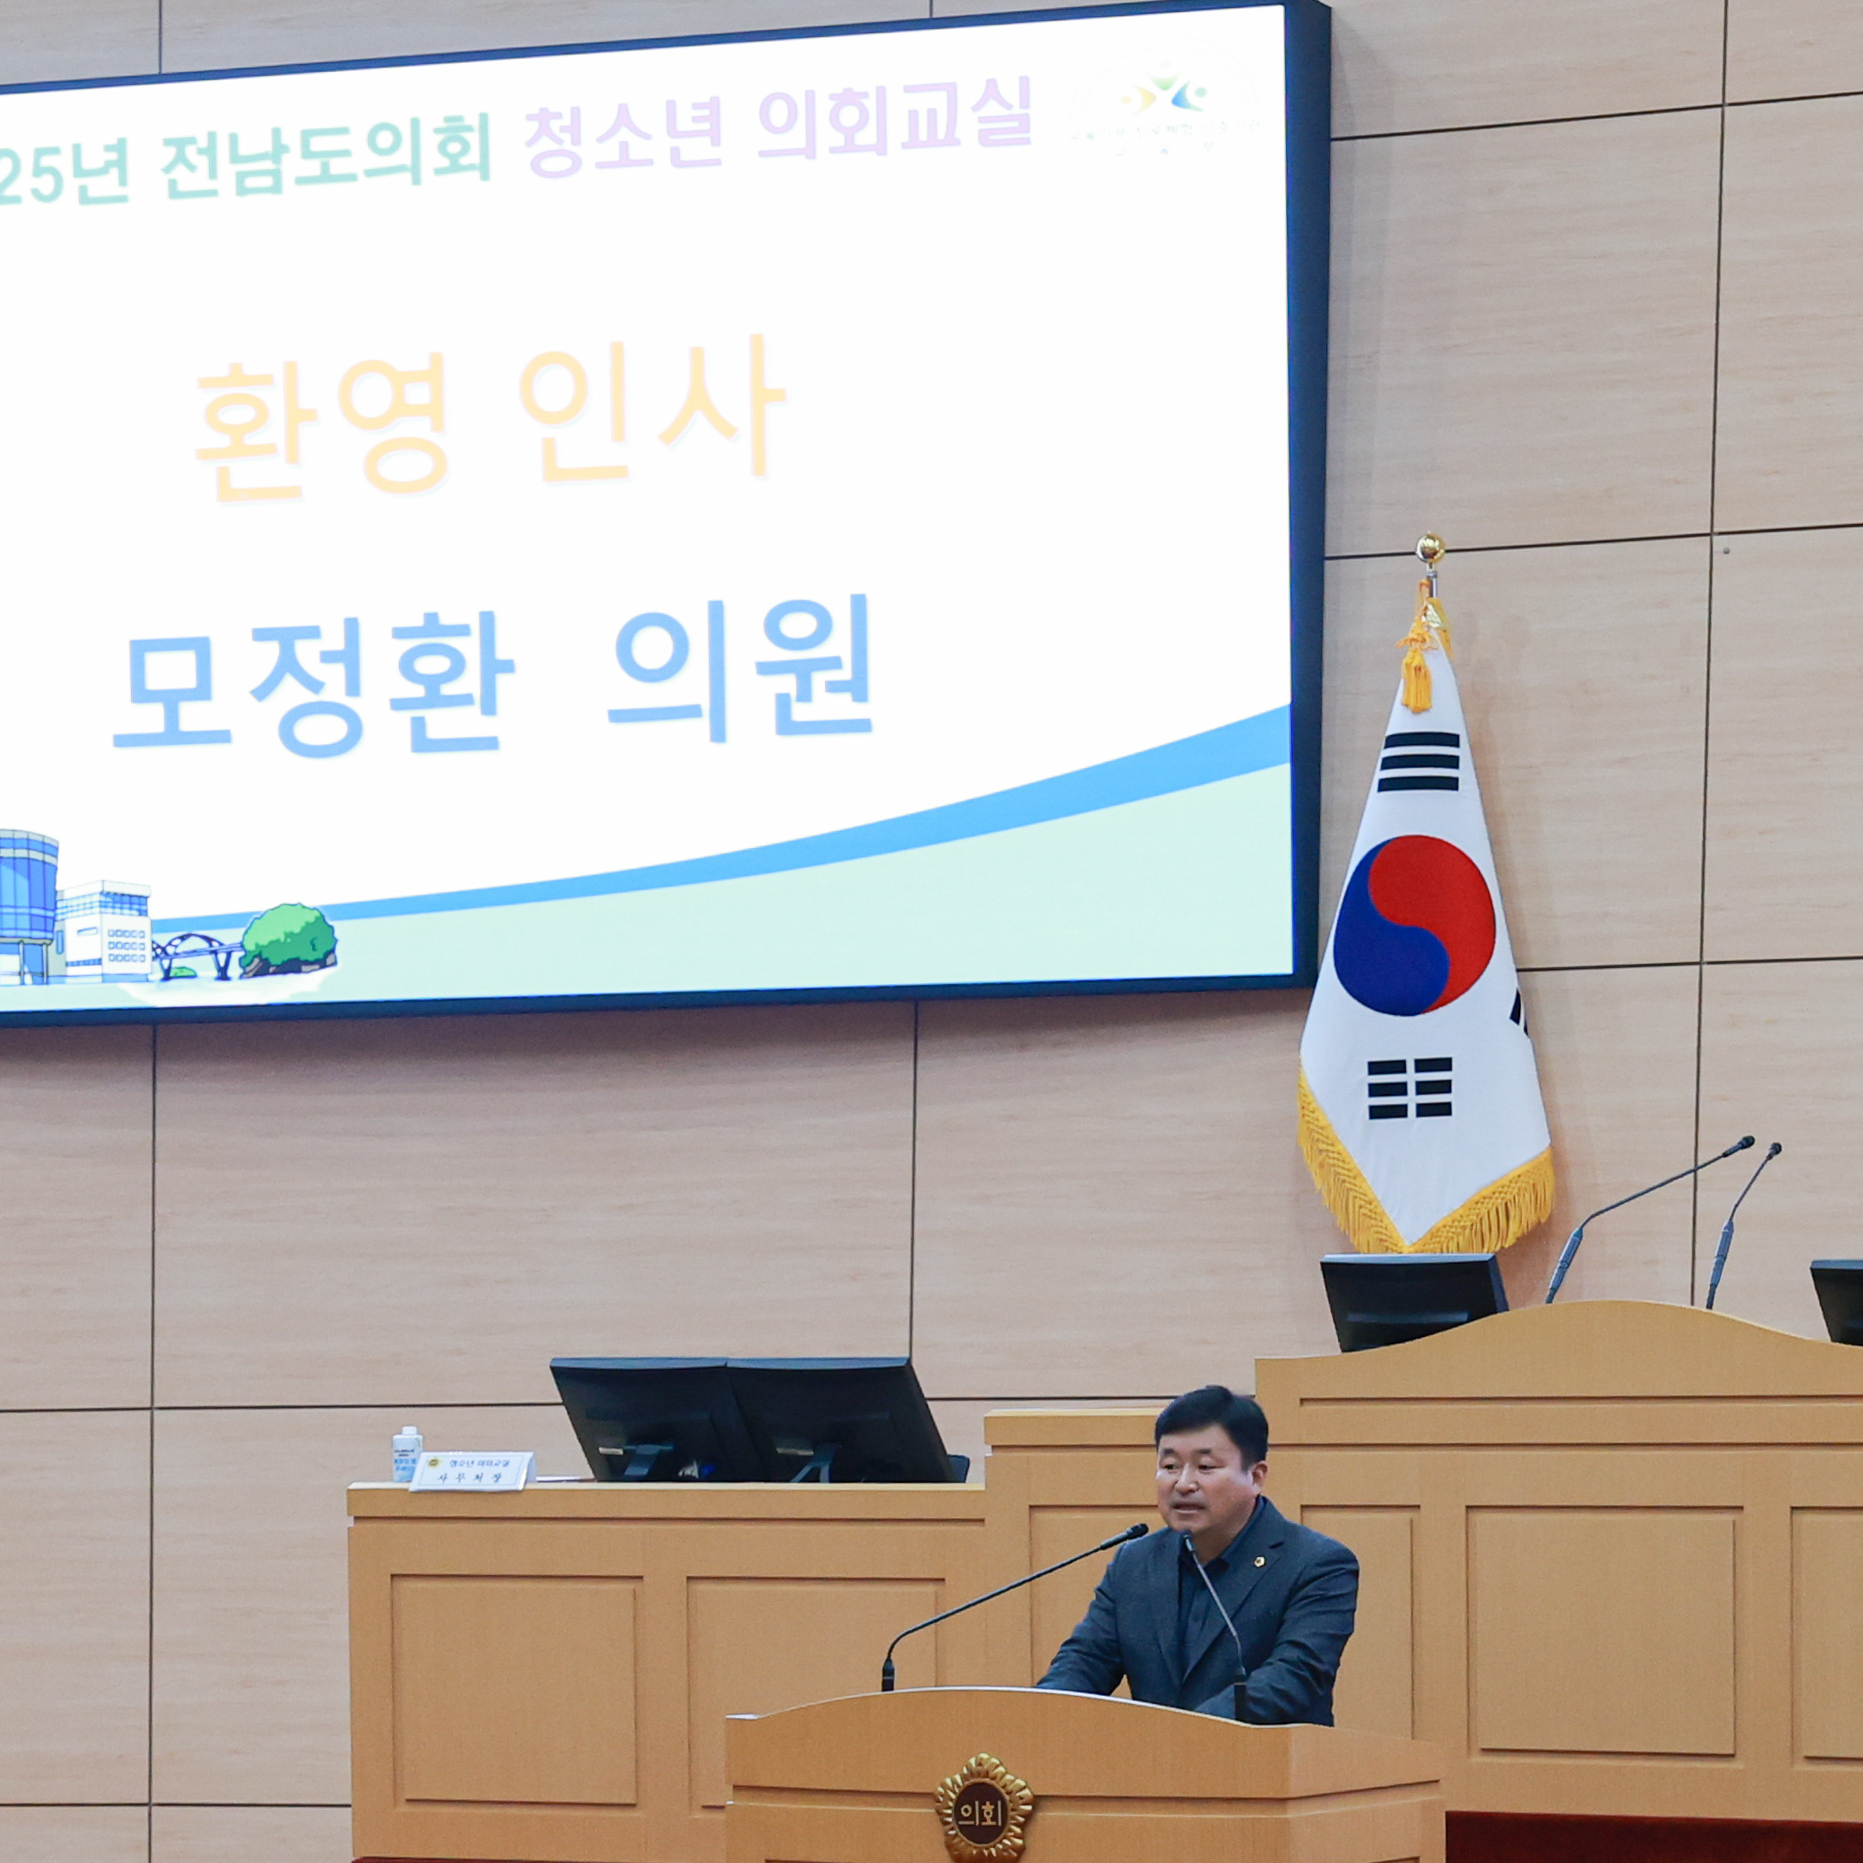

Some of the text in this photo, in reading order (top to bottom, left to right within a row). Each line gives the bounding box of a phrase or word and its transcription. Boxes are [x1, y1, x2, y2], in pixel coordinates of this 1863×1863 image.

[160, 112, 491, 200] 전남도의회
[523, 95, 723, 179] 청소년
[757, 76, 1033, 161] 의회교실
[193, 332, 790, 505] 환영 인사
[109, 593, 876, 763] 모정환 의원
[957, 1800, 1002, 1827] 의회
